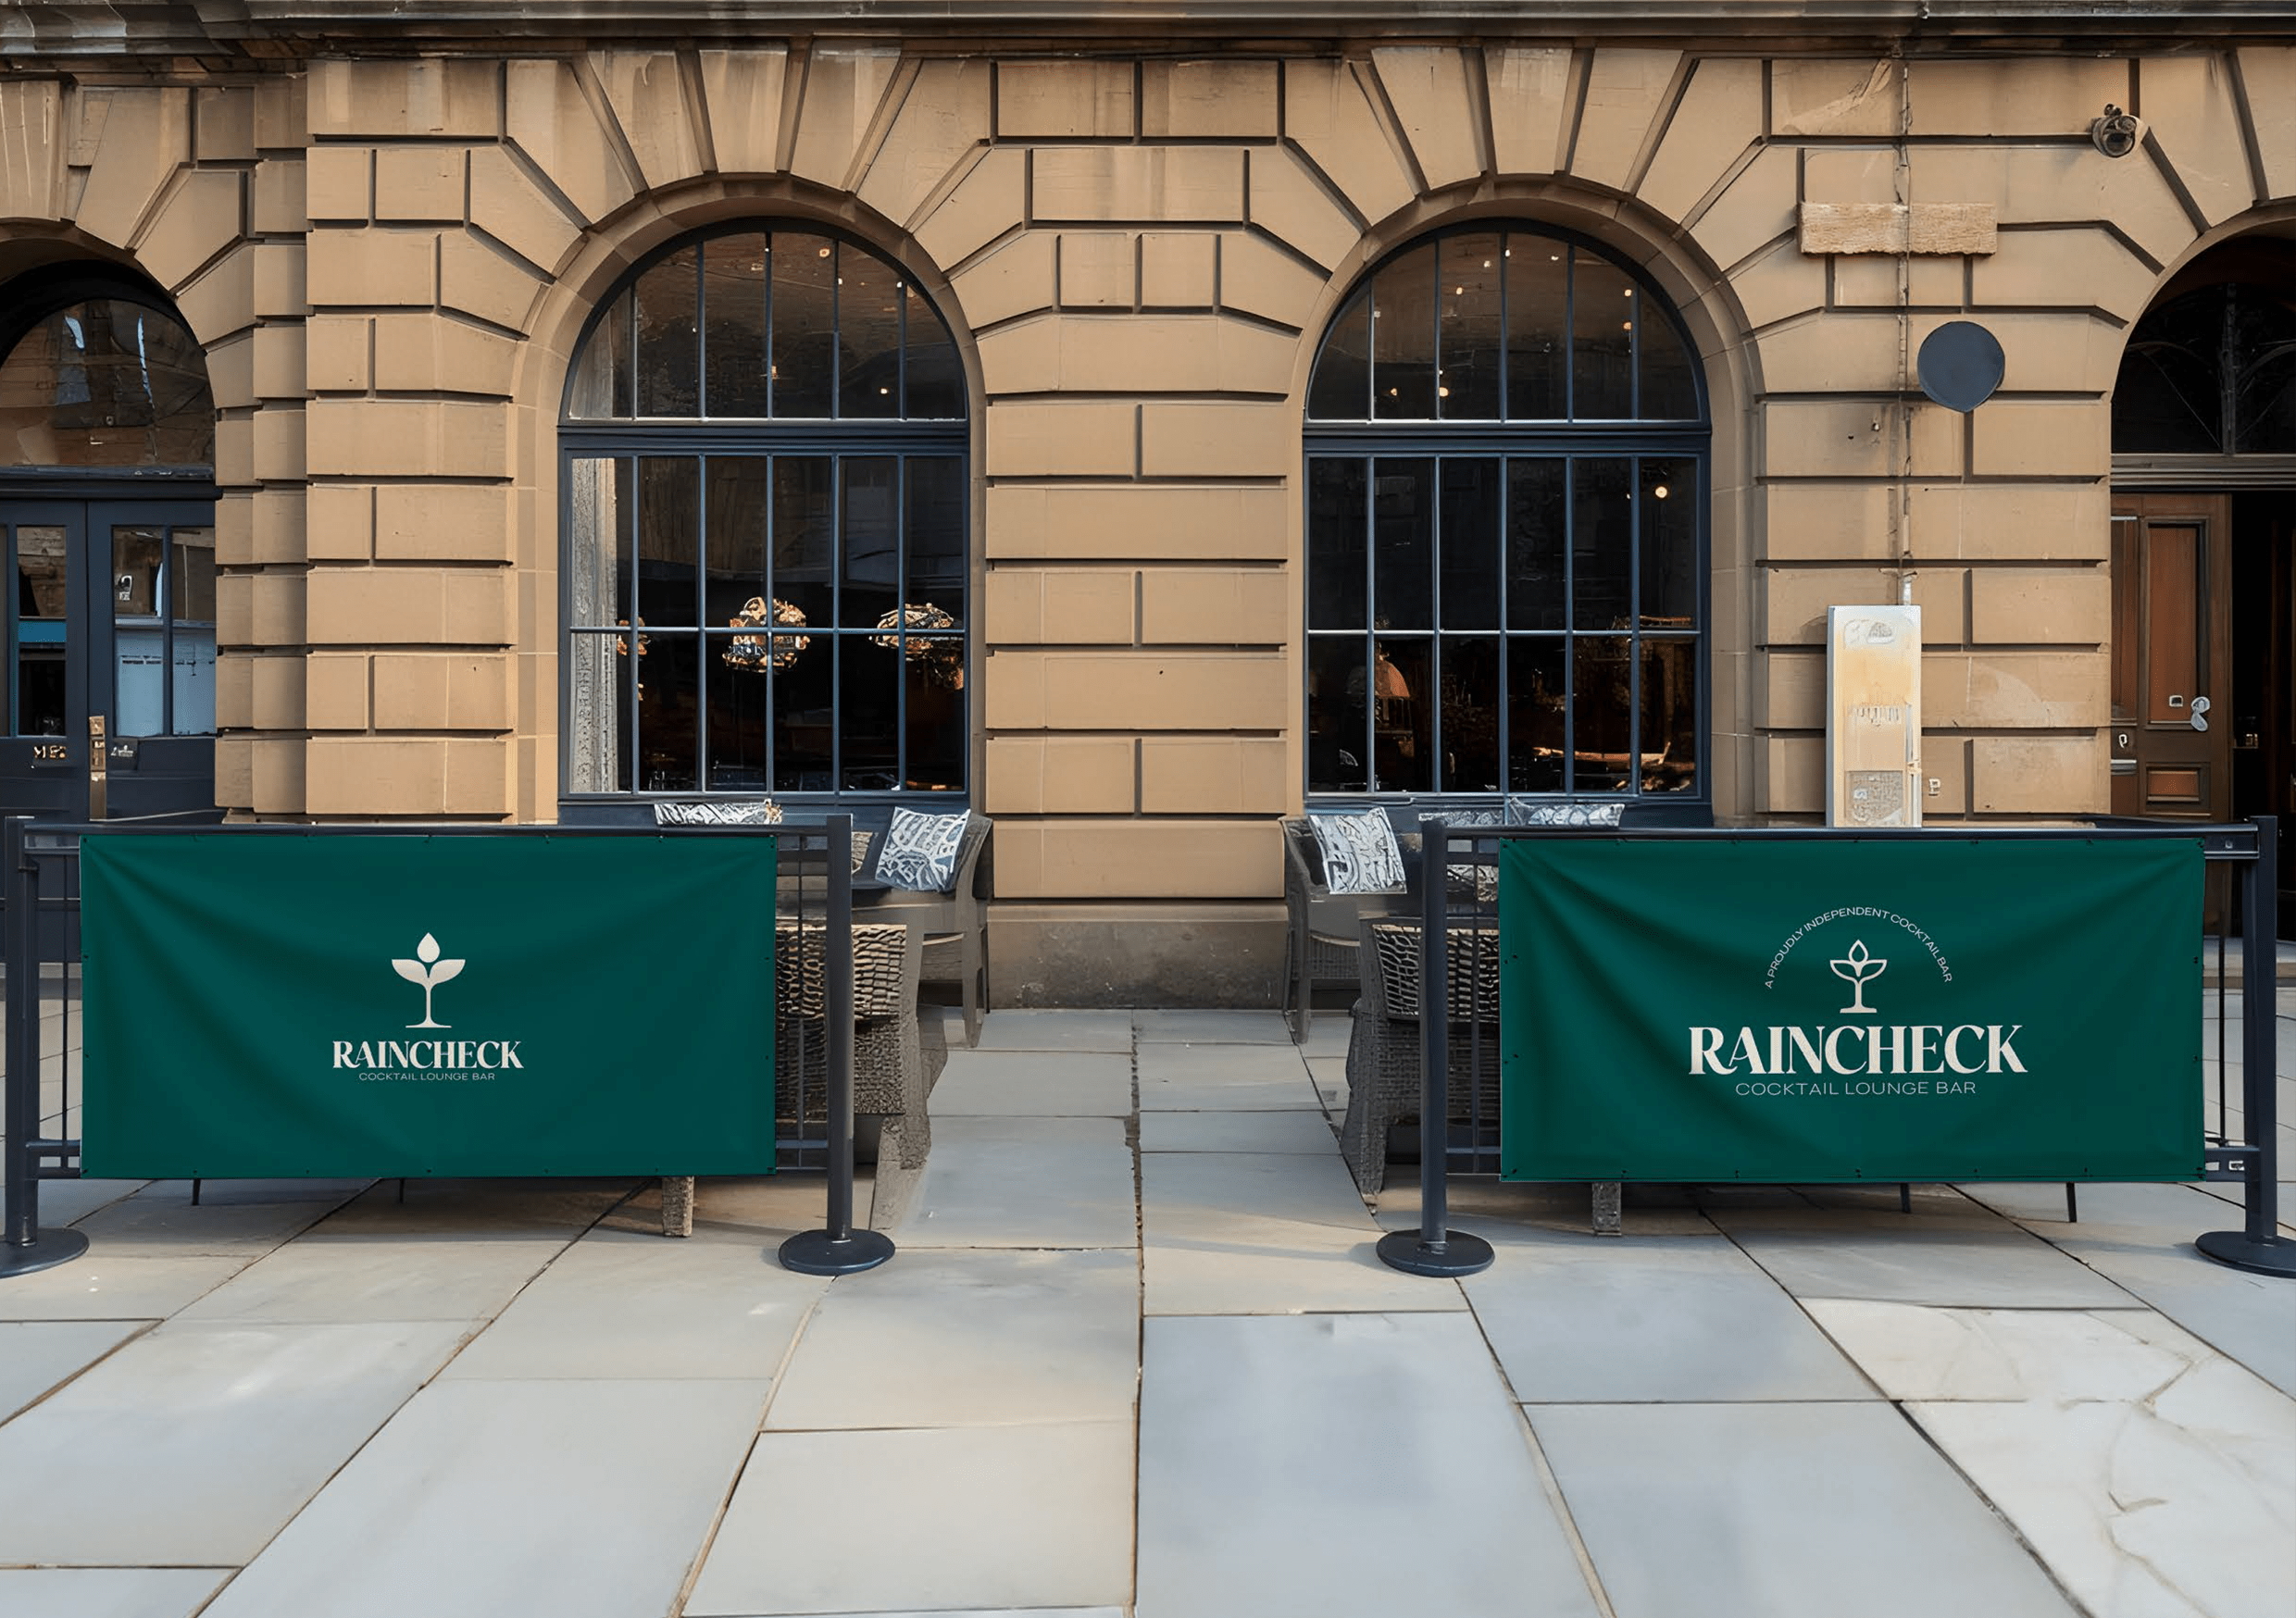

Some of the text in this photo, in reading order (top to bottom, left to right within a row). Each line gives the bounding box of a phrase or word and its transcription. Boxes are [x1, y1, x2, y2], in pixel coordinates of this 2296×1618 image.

[1765, 906, 1953, 989] A PROUDLY INDEPENDENT COCKTAIL BAR
[332, 1040, 524, 1069] RAINCHECK
[1688, 1024, 2028, 1075] RAINCHECK
[358, 1072, 495, 1081] COCKTAIL LOUNGE BAR
[1735, 1081, 1976, 1096] COCKTAIL LOUNGE BAR
